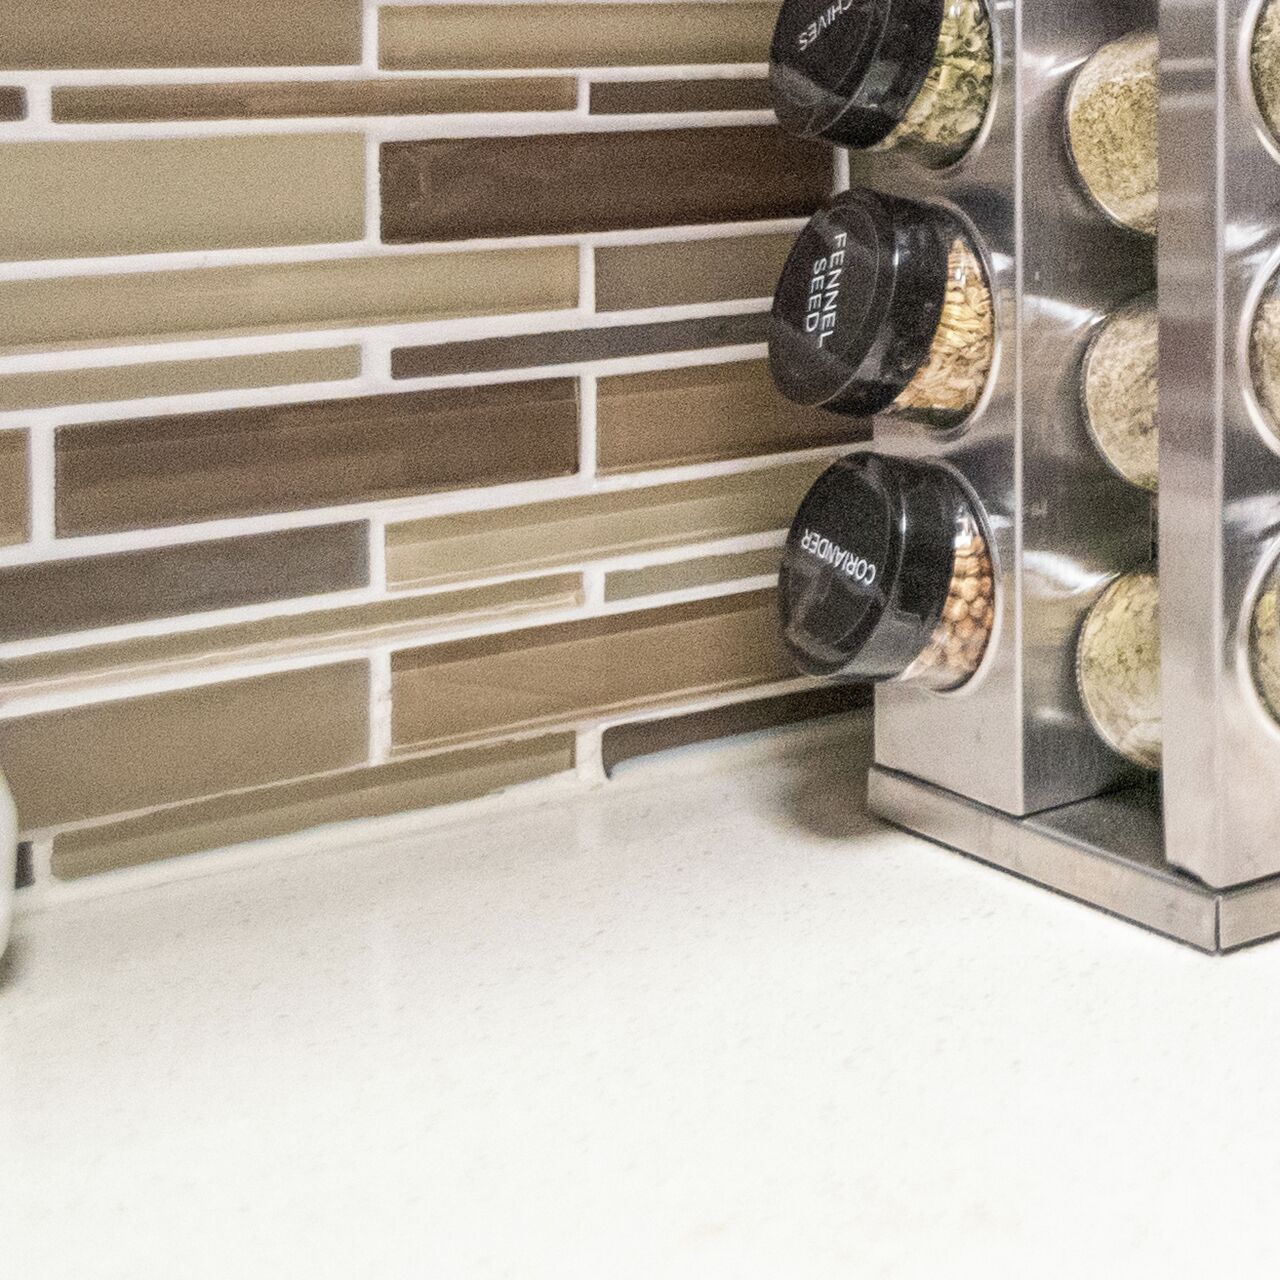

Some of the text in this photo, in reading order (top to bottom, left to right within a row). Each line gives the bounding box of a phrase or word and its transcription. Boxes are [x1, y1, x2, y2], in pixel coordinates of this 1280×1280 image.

[804, 256, 827, 334] SEED
[818, 231, 847, 348] FENNEL
[801, 527, 876, 586] CORIANDER
